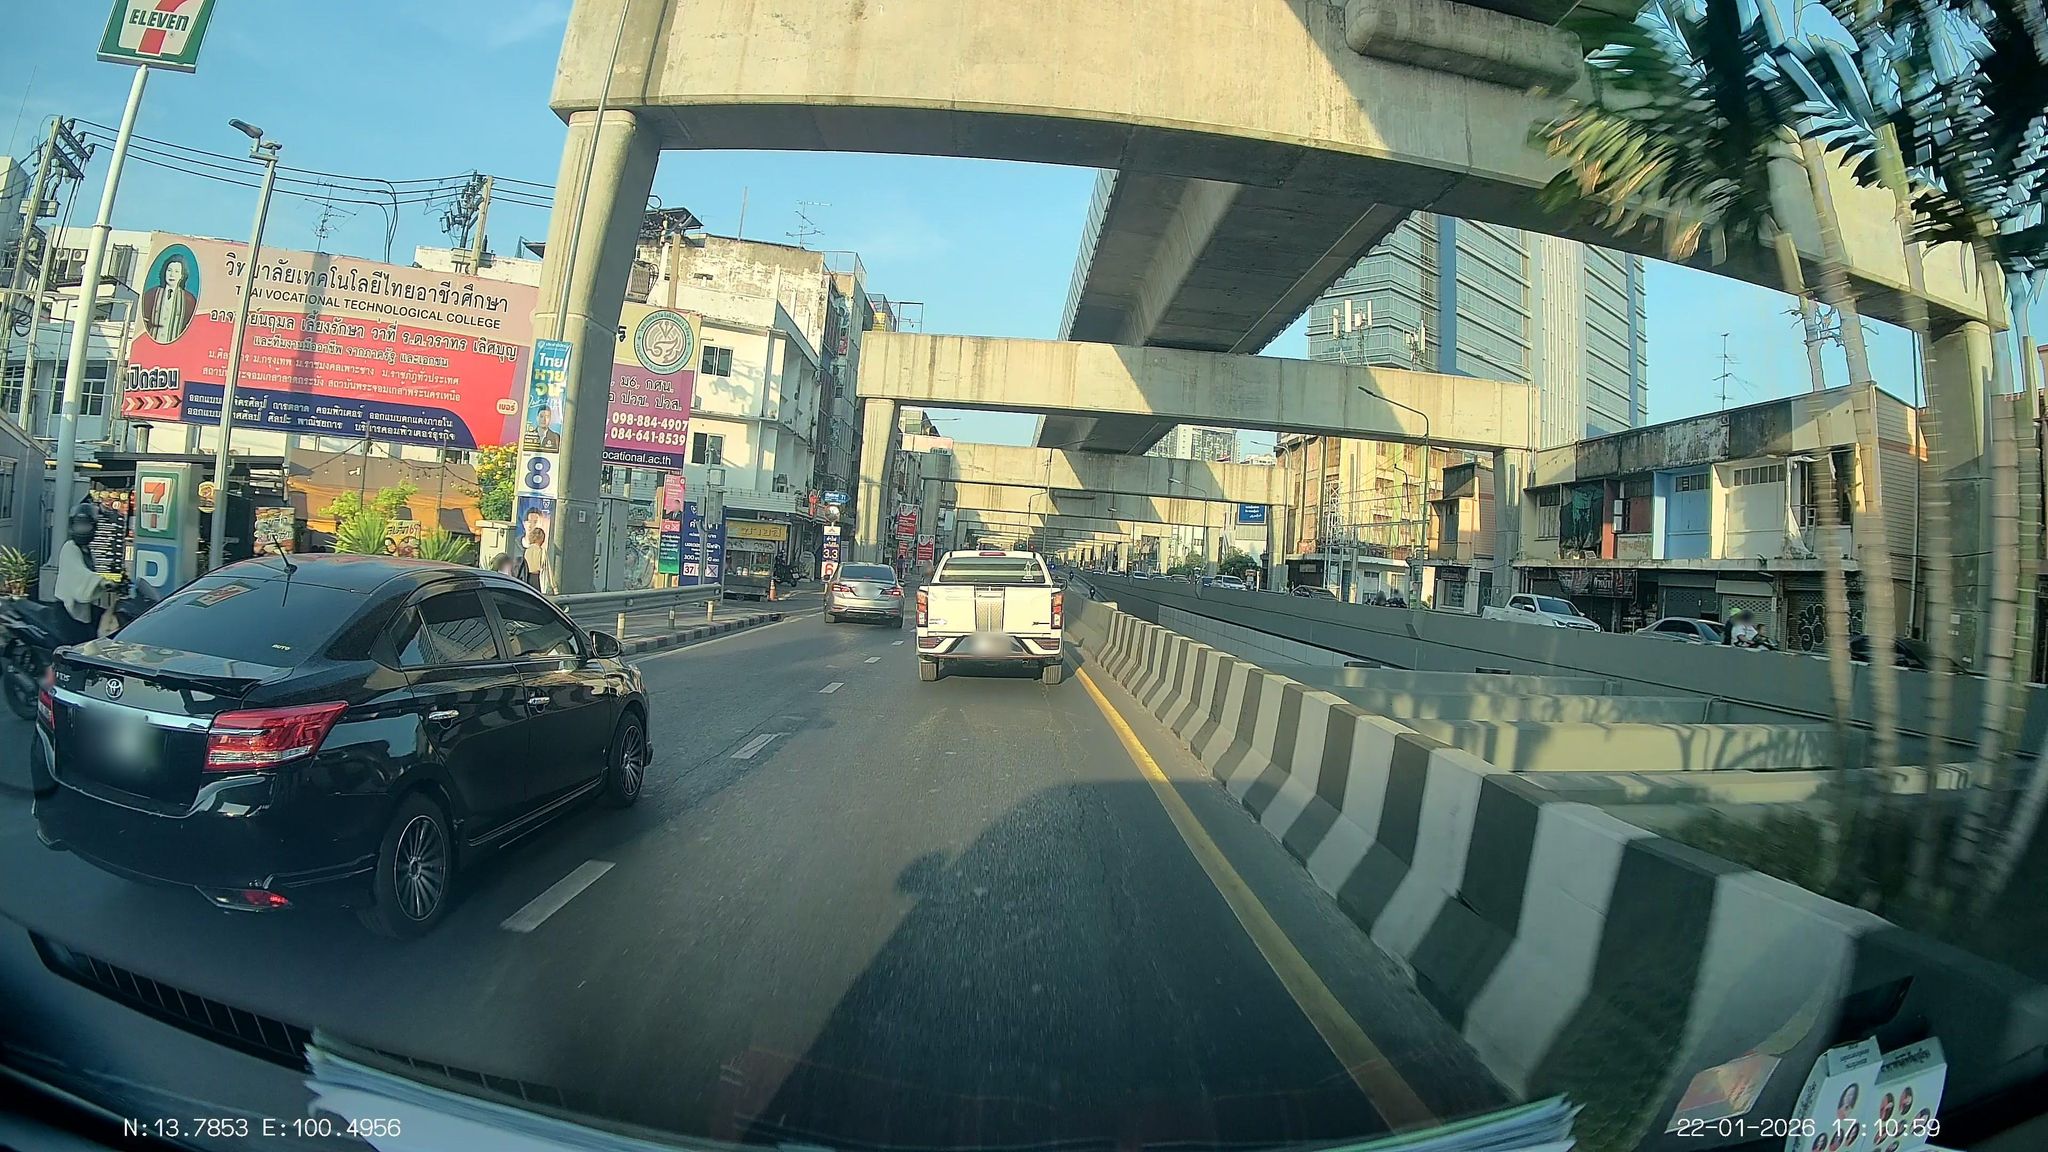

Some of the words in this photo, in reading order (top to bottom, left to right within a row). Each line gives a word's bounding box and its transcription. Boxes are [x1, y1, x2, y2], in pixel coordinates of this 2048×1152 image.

[235, 285, 263, 299] TAI
[266, 290, 340, 308] VOCATIONAL
[343, 299, 443, 322] TECHNOLOGICAL
[446, 313, 501, 329] COLLEGE
[612, 411, 688, 432] 098-884-4907
[610, 427, 686, 447] 084-641-8539
[525, 456, 551, 489] 8
[823, 549, 839, 559] 3.3
[684, 566, 694, 575] 37
